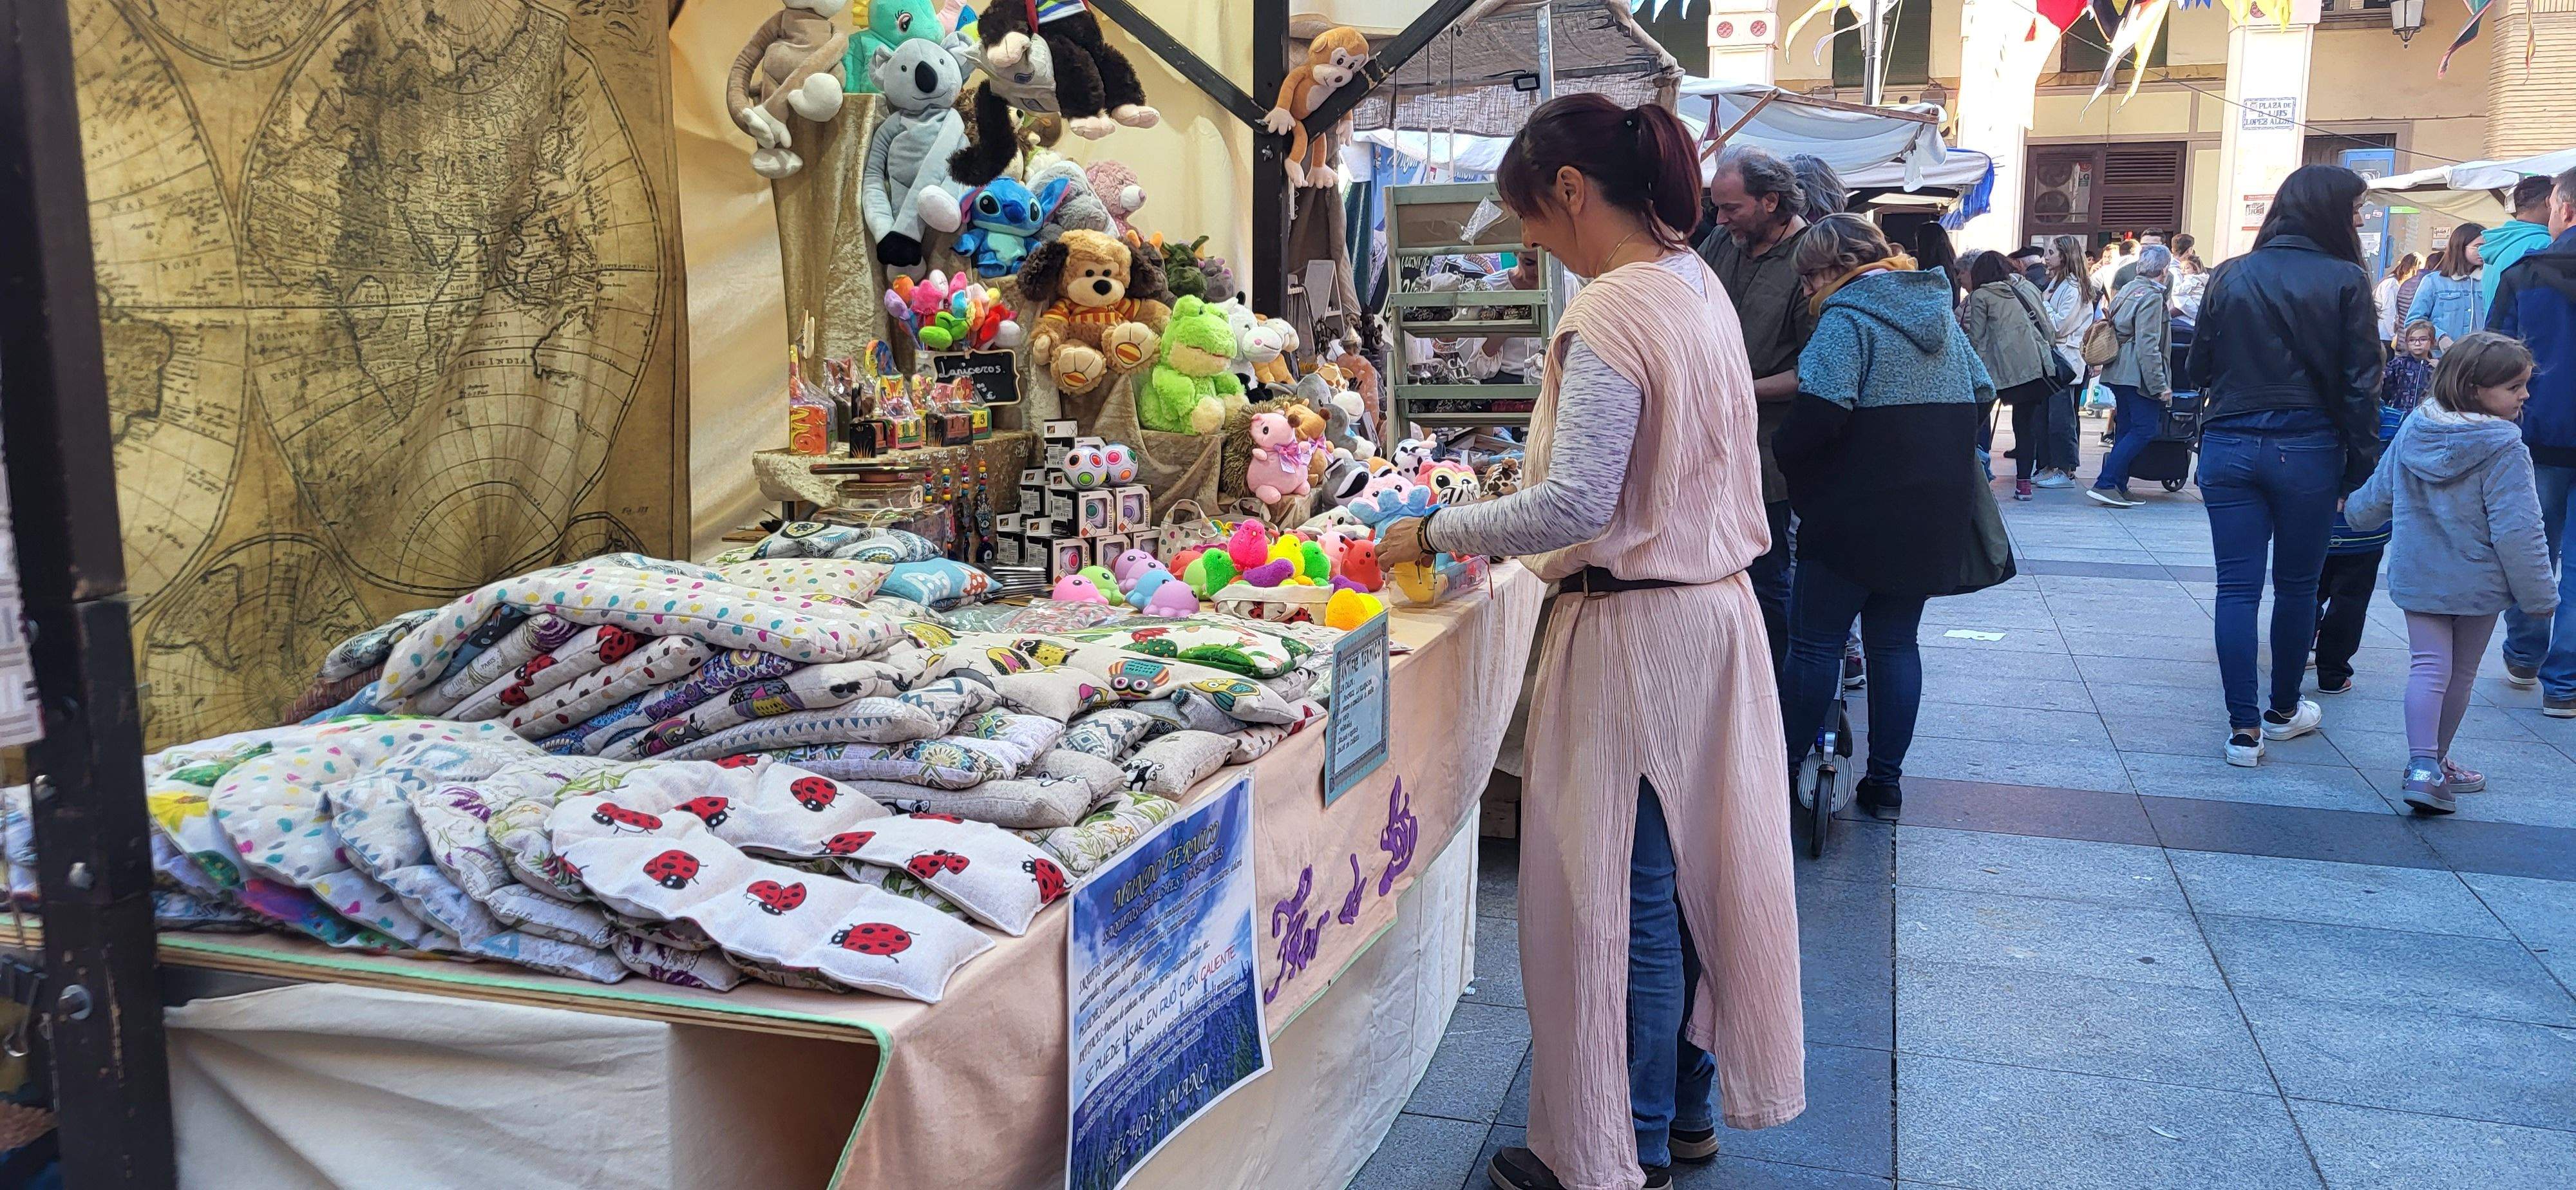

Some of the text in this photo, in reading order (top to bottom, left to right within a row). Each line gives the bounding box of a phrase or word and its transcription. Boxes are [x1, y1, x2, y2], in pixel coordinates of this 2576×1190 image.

[1112, 862, 1162, 914] MUNDO
[1084, 1064, 1094, 1089] SE
[1095, 1037, 1121, 1073] PUEDE
[1146, 1004, 1158, 1024] EN
[1187, 971, 1198, 990] EN
[1198, 945, 1236, 980] CALIENTE
[1106, 1061, 1209, 1170] HECHOS A MANO
